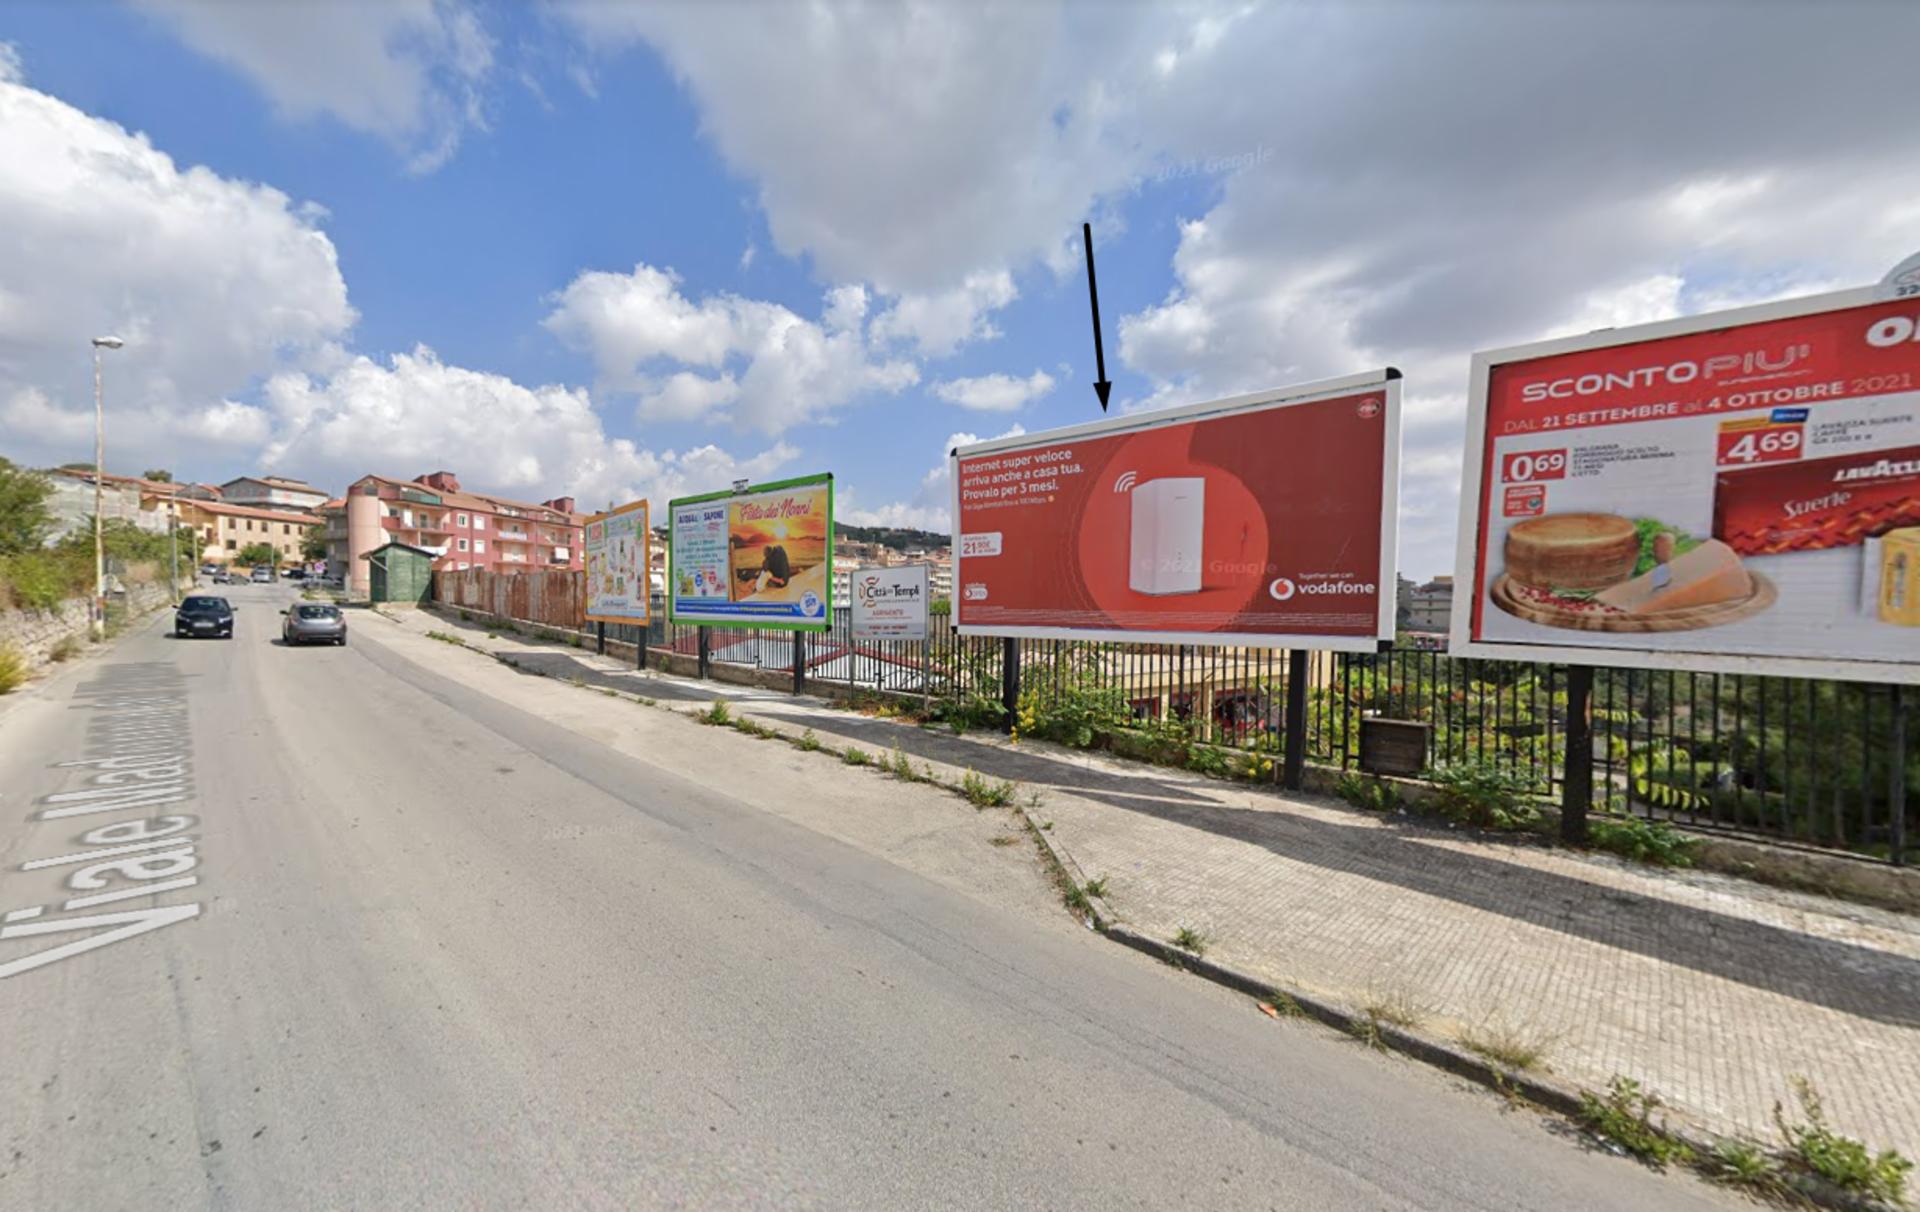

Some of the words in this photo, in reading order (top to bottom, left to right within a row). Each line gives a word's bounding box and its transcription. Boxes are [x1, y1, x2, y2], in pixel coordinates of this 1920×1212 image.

[1504, 420, 1537, 434] DAL
[1542, 415, 1560, 428] 21
[1564, 402, 1679, 427] SETTEMBRE
[1708, 397, 1721, 409] 4
[1727, 381, 1846, 407] OTTOBRE
[1851, 372, 1912, 393] 2021
[962, 460, 1001, 474] Internet
[1002, 456, 1032, 469] super
[1034, 450, 1073, 463] veloce
[963, 475, 990, 487] arriva
[991, 470, 1022, 483] anche
[1023, 470, 1031, 479] a
[1032, 466, 1059, 478] casa
[1060, 463, 1085, 475] tua.
[963, 486, 999, 501] Provalo
[1001, 484, 1018, 498] per
[1019, 482, 1027, 494] 3
[1028, 479, 1059, 493] mesi.
[1783, 491, 1852, 521] Suerte
[1298, 580, 1376, 595] vodafone
